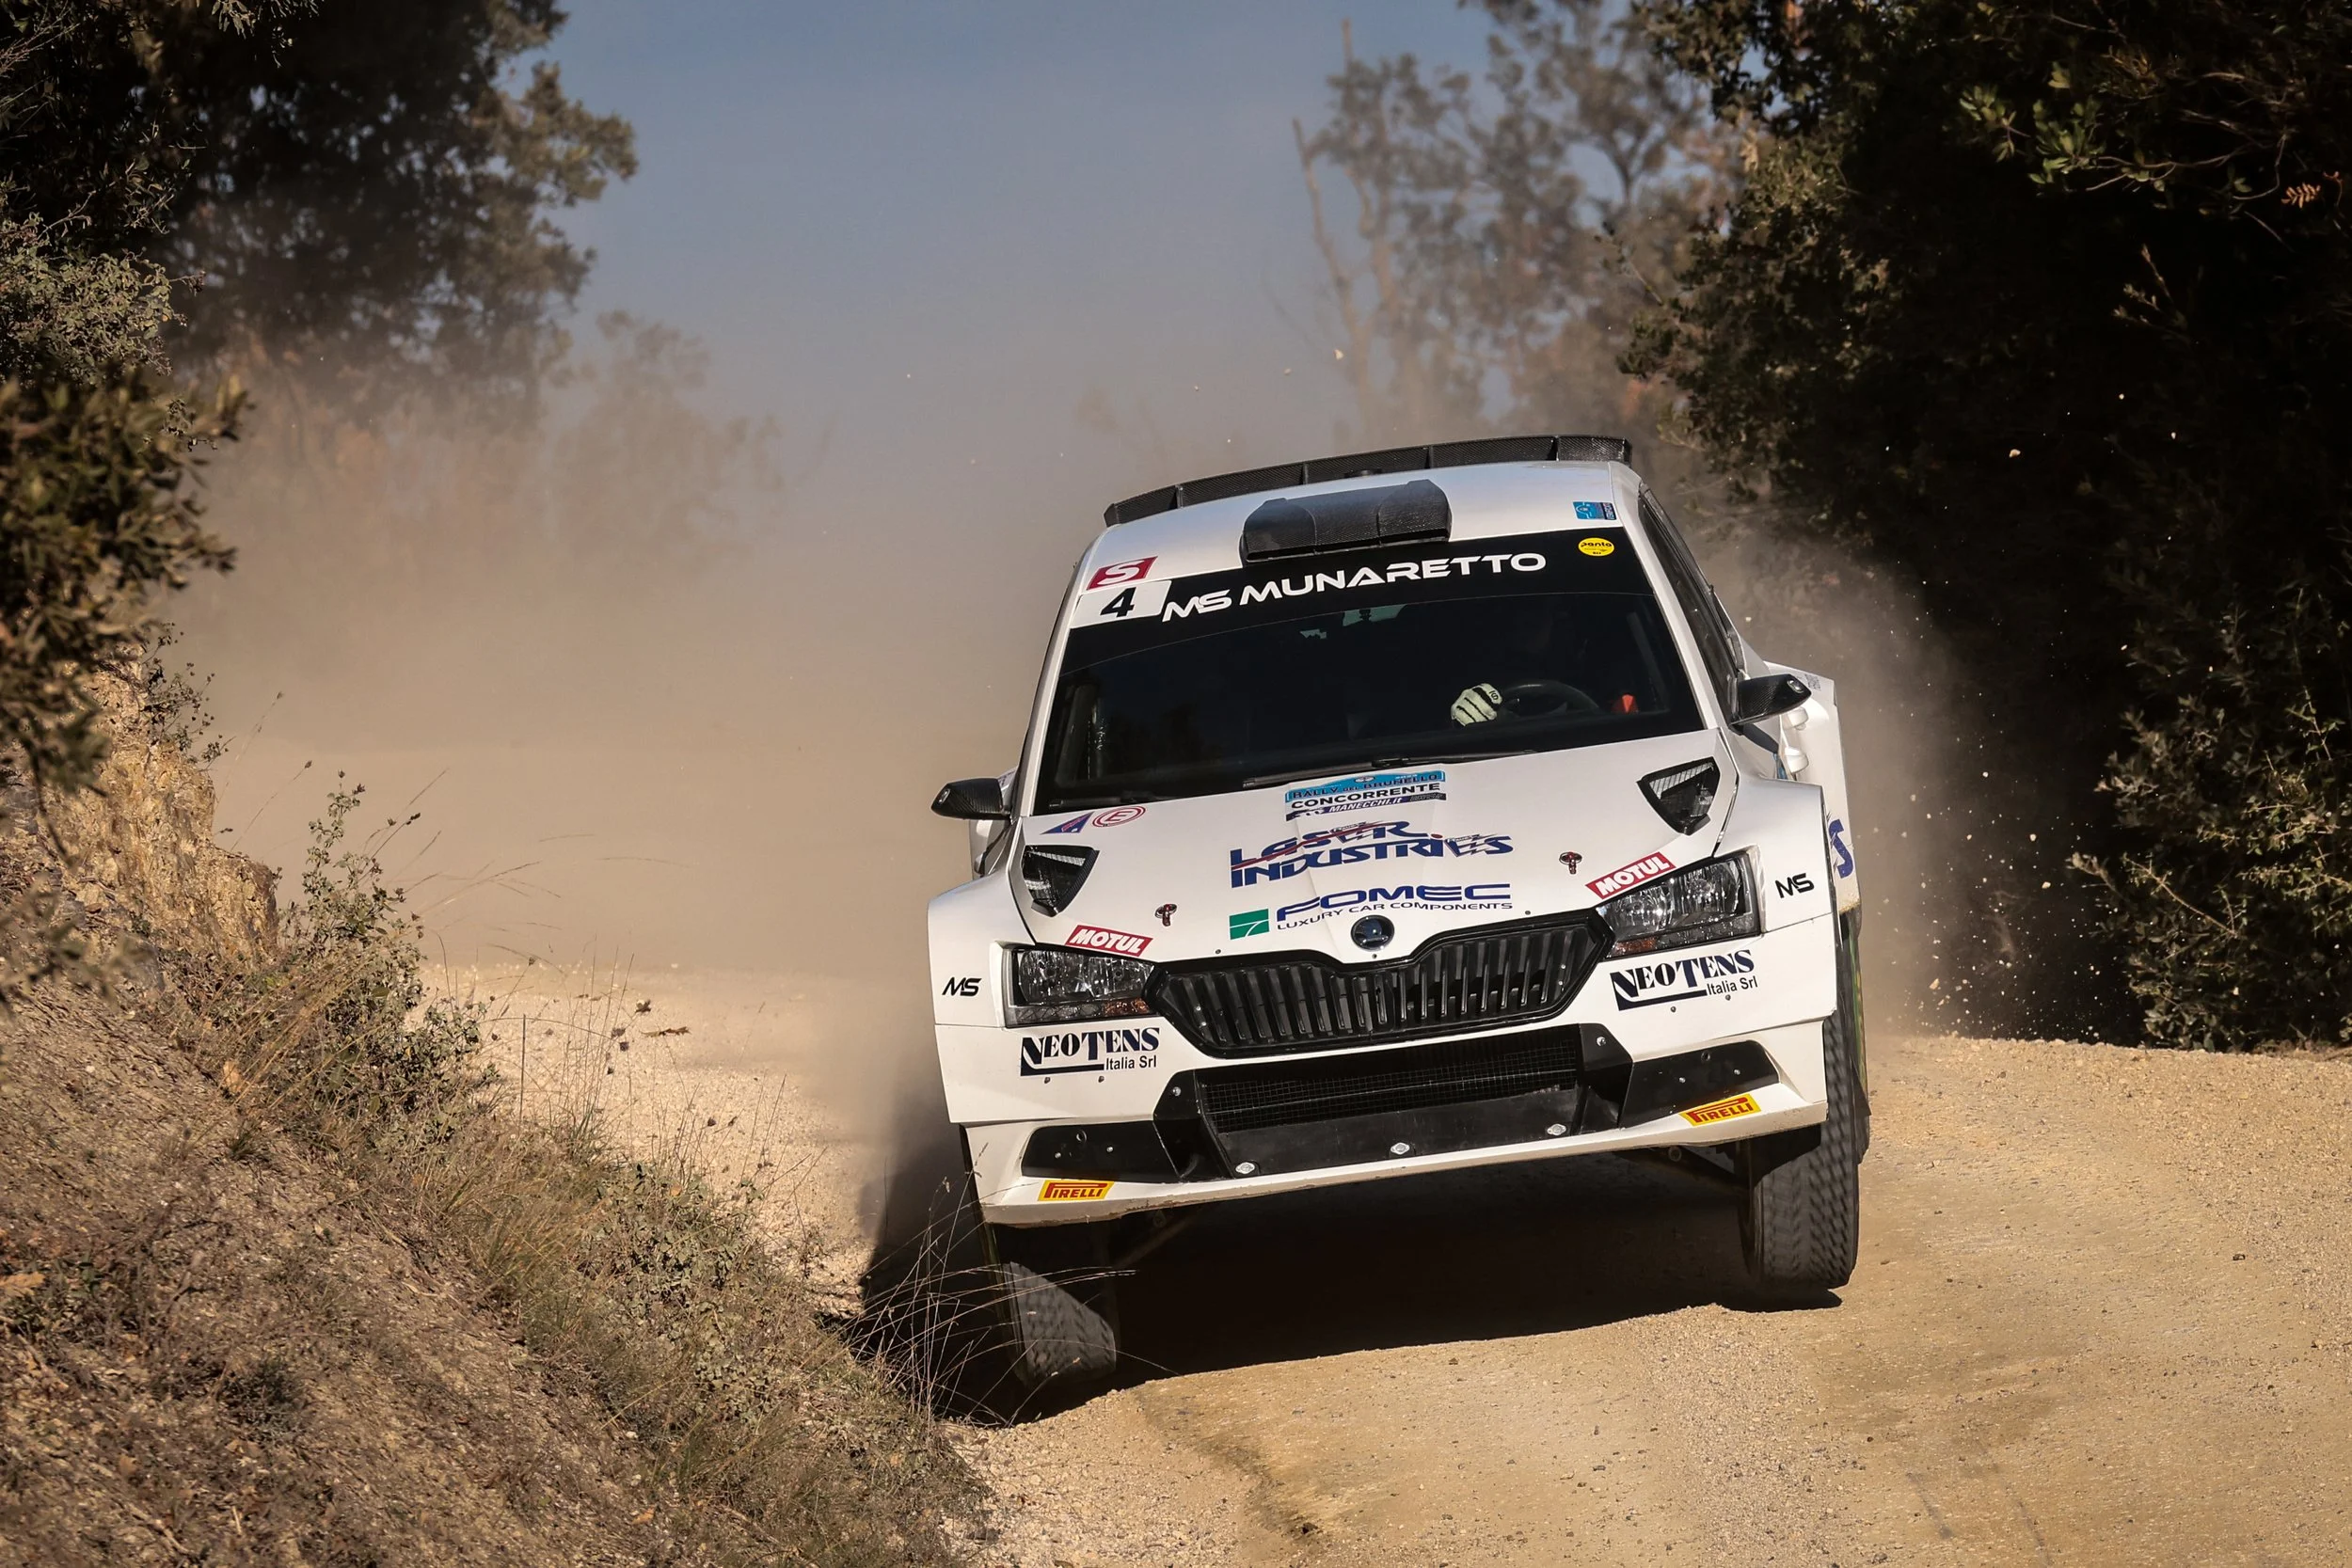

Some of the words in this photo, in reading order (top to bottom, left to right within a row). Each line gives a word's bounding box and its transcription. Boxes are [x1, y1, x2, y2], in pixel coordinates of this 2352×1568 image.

[1162, 589, 1232, 622] MS
[1239, 552, 1547, 607] MUNARETTO
[1100, 587, 1136, 618] 4
[1291, 783, 1440, 809] CONCORRENTE
[1293, 787, 1338, 799] RALLY
[1363, 774, 1438, 789] BRUNELLO
[1328, 797, 1403, 814] MANECCHI.it
[1231, 833, 1514, 888] INDUSTRIES
[1598, 855, 1670, 896] MOTUL
[1774, 872, 1815, 899] MS
[1277, 884, 1511, 922] FOMEC
[1278, 909, 1343, 929] LUXURY
[1348, 903, 1385, 913] CAR
[1390, 902, 1513, 911] COMPONENTS
[1069, 927, 1145, 954] MOTUL
[942, 976, 982, 997] MS
[1610, 949, 1756, 999] NEOTENS
[1706, 980, 1739, 996] Italia
[1740, 975, 1758, 990] Srl
[1021, 1027, 1160, 1065] NEOTENS
[1105, 1056, 1136, 1071] Italia
[1138, 1054, 1157, 1069] Srl
[1686, 1097, 1754, 1123] PIRELLI
[1043, 1182, 1108, 1198] PIRELLI
